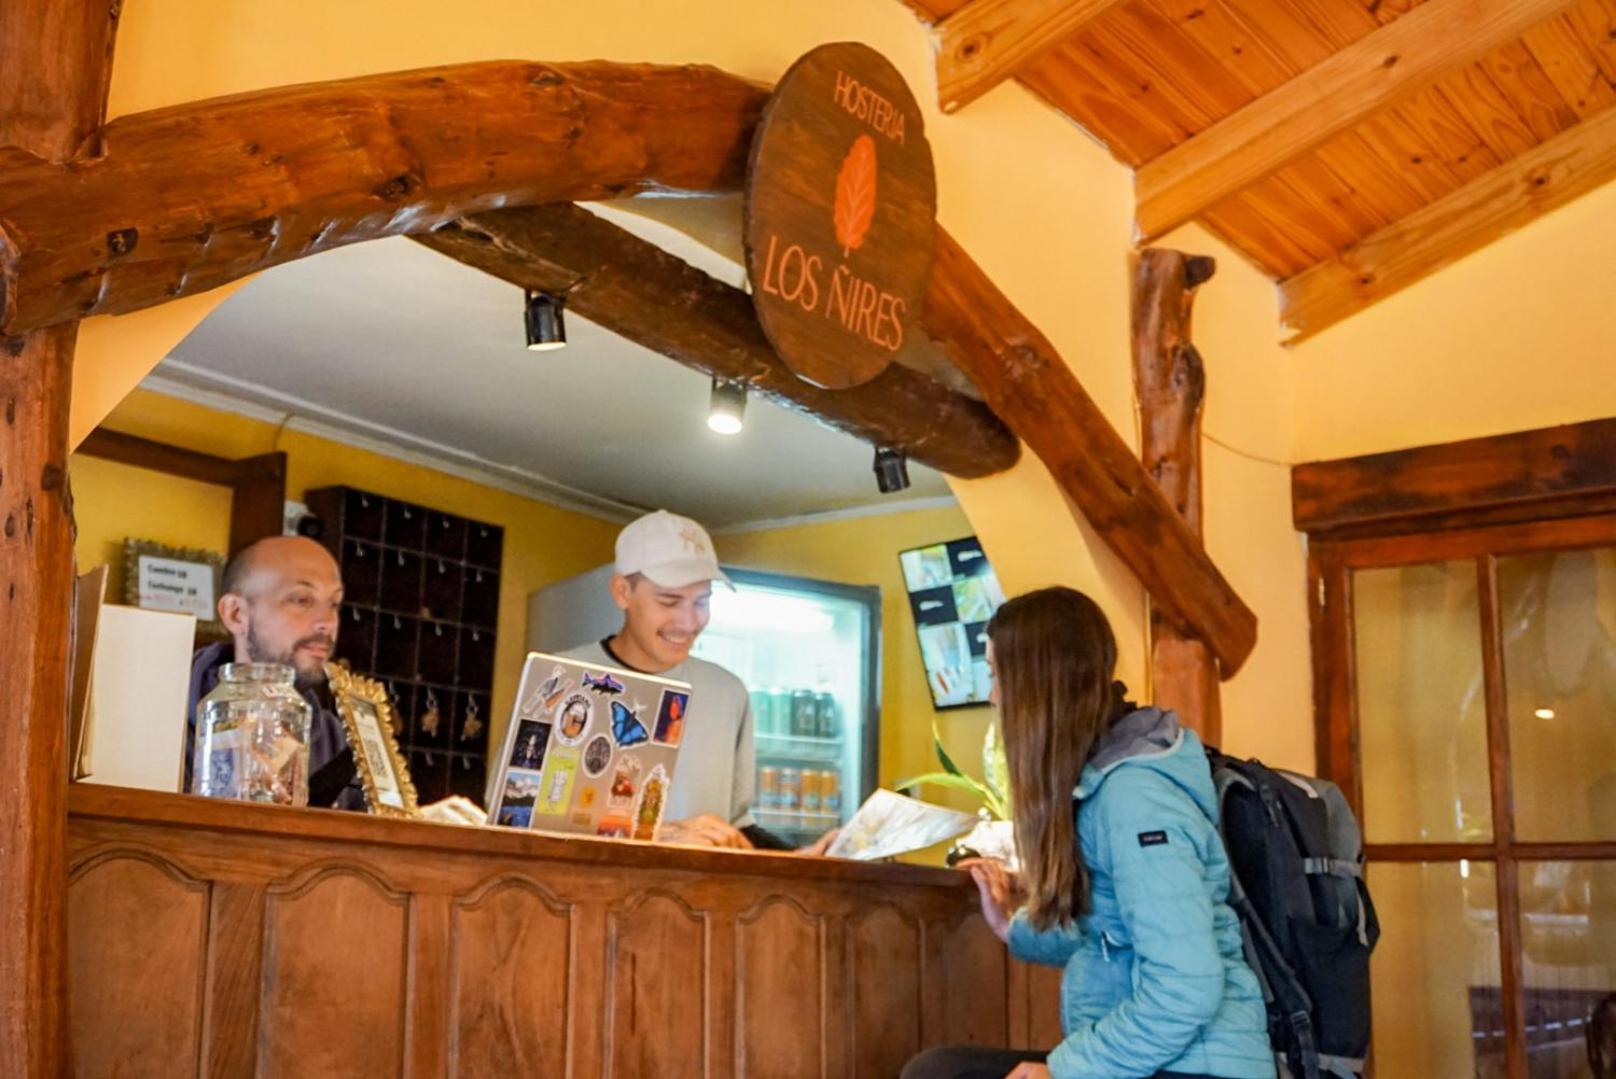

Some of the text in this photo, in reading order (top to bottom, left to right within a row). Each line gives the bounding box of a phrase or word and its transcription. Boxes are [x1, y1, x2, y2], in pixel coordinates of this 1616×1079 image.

[833, 70, 905, 146] HOSTERIA
[762, 235, 906, 351] LOS ÑIRES
